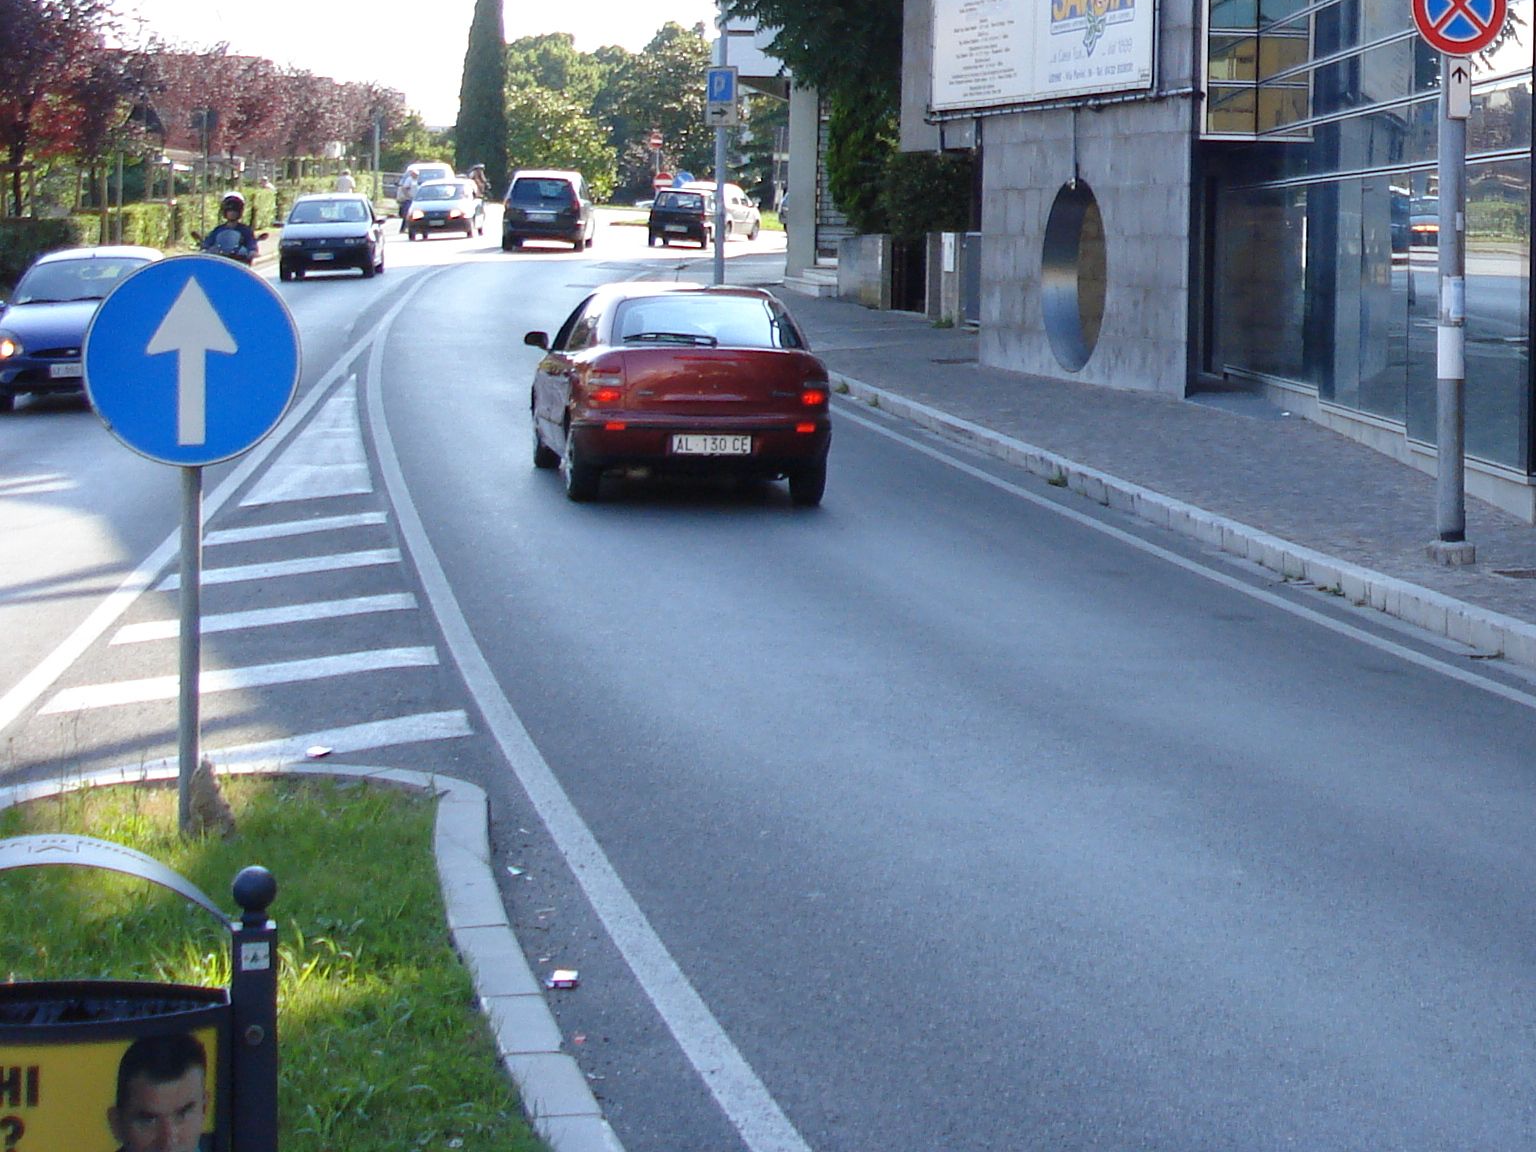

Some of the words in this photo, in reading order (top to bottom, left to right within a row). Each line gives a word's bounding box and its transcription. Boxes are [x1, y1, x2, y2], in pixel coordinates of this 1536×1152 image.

[714, 76, 725, 97] P
[675, 438, 693, 452] AL
[703, 438, 727, 452] 130
[732, 437, 749, 452] CE
